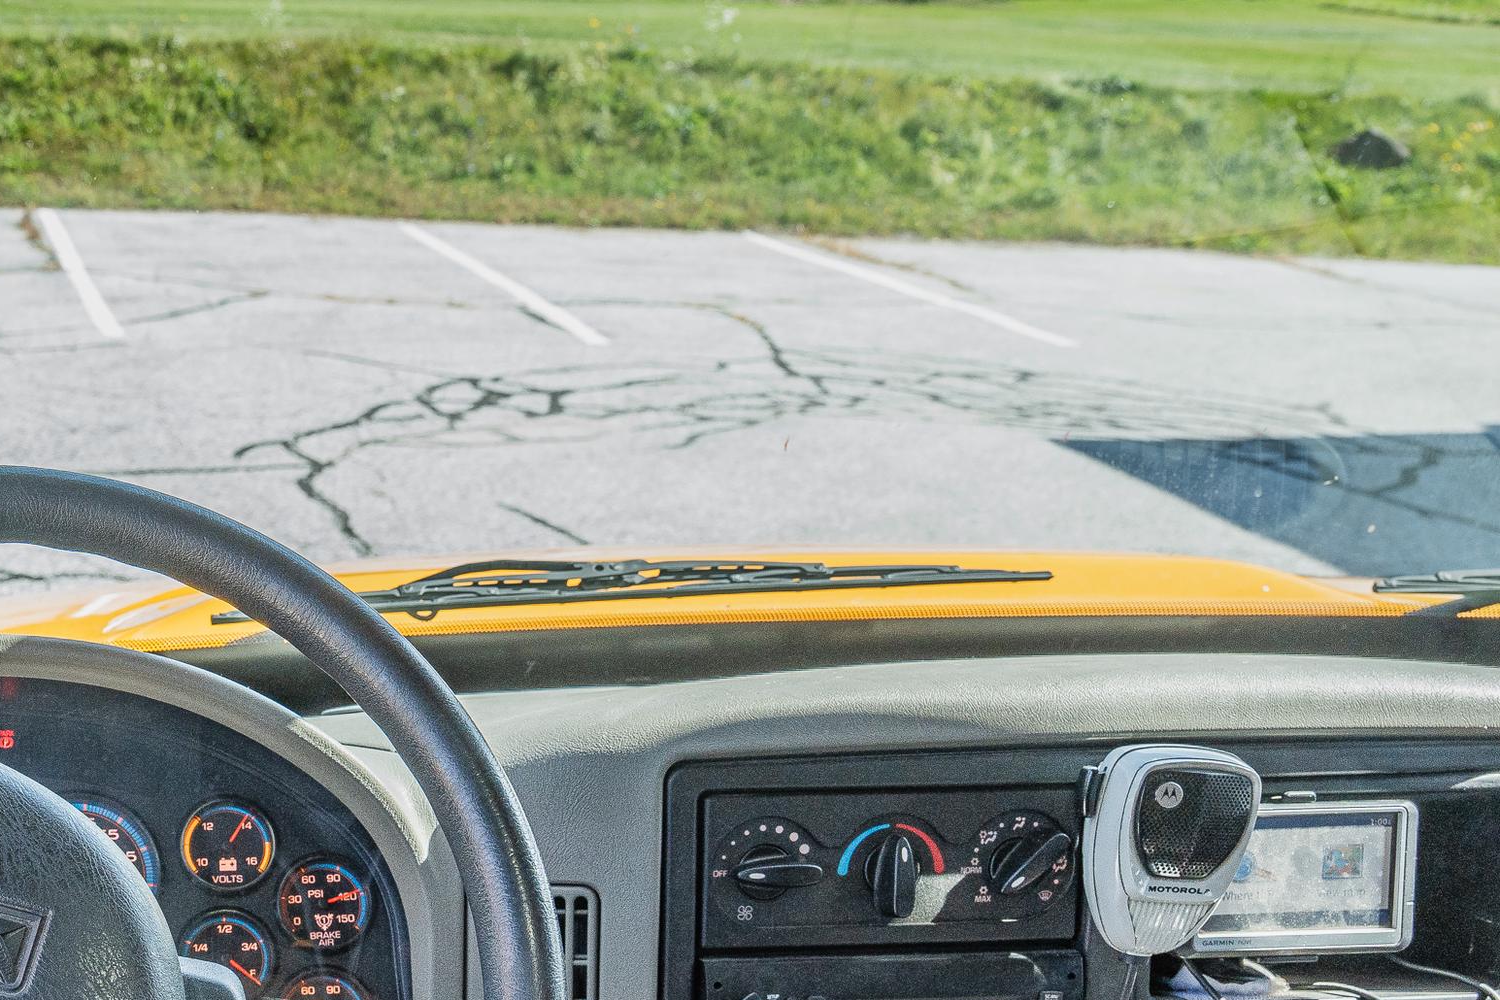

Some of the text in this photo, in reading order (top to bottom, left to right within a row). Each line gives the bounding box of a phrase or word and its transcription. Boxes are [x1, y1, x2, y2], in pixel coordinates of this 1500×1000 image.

[202, 823, 213, 831] 12
[196, 858, 208, 866] 10
[246, 857, 257, 865] 16
[713, 870, 728, 878] OFF
[961, 866, 982, 874] NORM
[212, 875, 243, 883] VOLTS
[301, 875, 315, 884] 60
[326, 874, 340, 882] 90
[308, 890, 324, 898] PSI
[1148, 885, 1212, 895] MOTOROLA
[288, 895, 302, 903] 30
[293, 917, 301, 925] 0
[336, 914, 355, 923] 150
[217, 925, 232, 933] 1/2
[310, 931, 340, 939] BRAKE
[1202, 939, 1234, 947] GARMIN
[193, 944, 208, 952] 1/4
[301, 987, 315, 995] 60
[326, 986, 340, 994] 90
